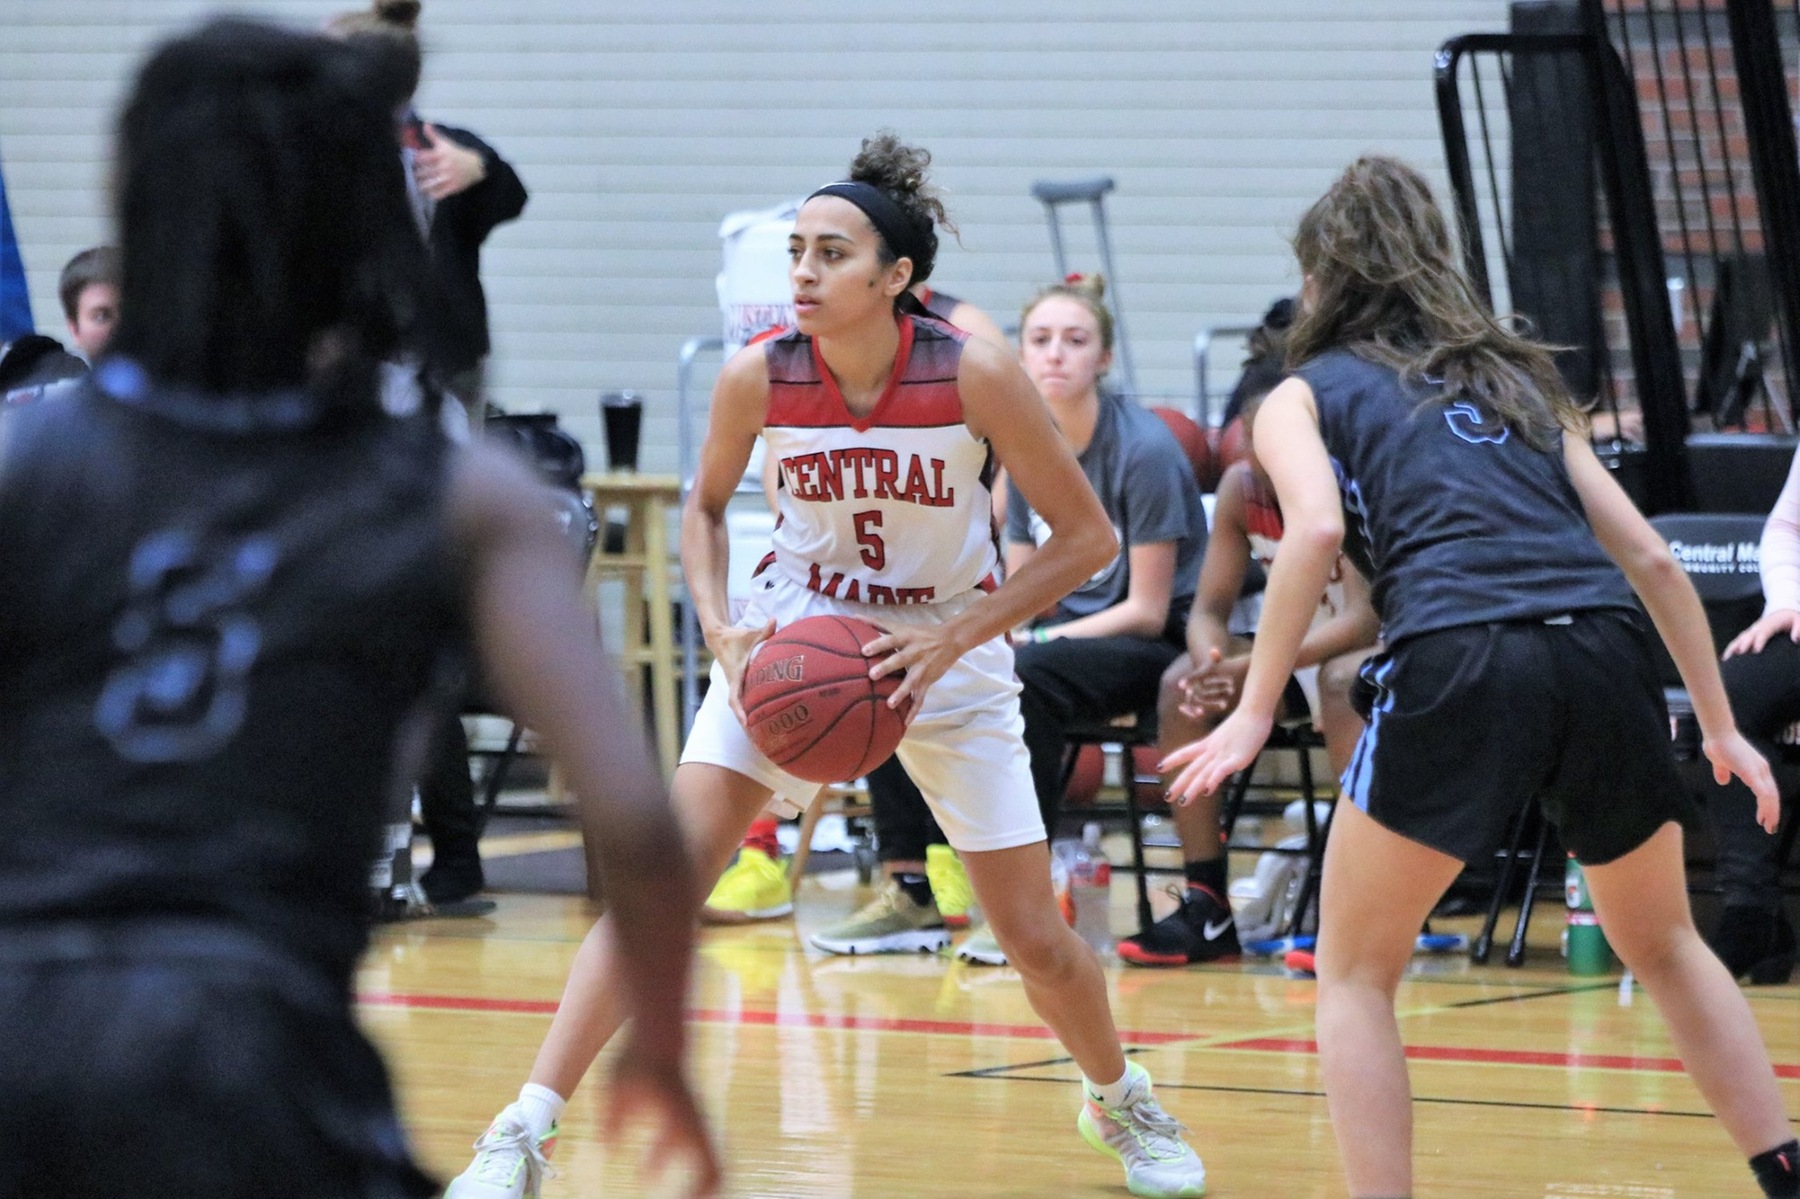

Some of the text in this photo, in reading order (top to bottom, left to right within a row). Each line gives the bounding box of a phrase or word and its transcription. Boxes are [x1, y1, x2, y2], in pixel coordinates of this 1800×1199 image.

[780, 447, 954, 507] CENTRAL
[853, 510, 886, 571] 5
[1669, 540, 1735, 562] Central
